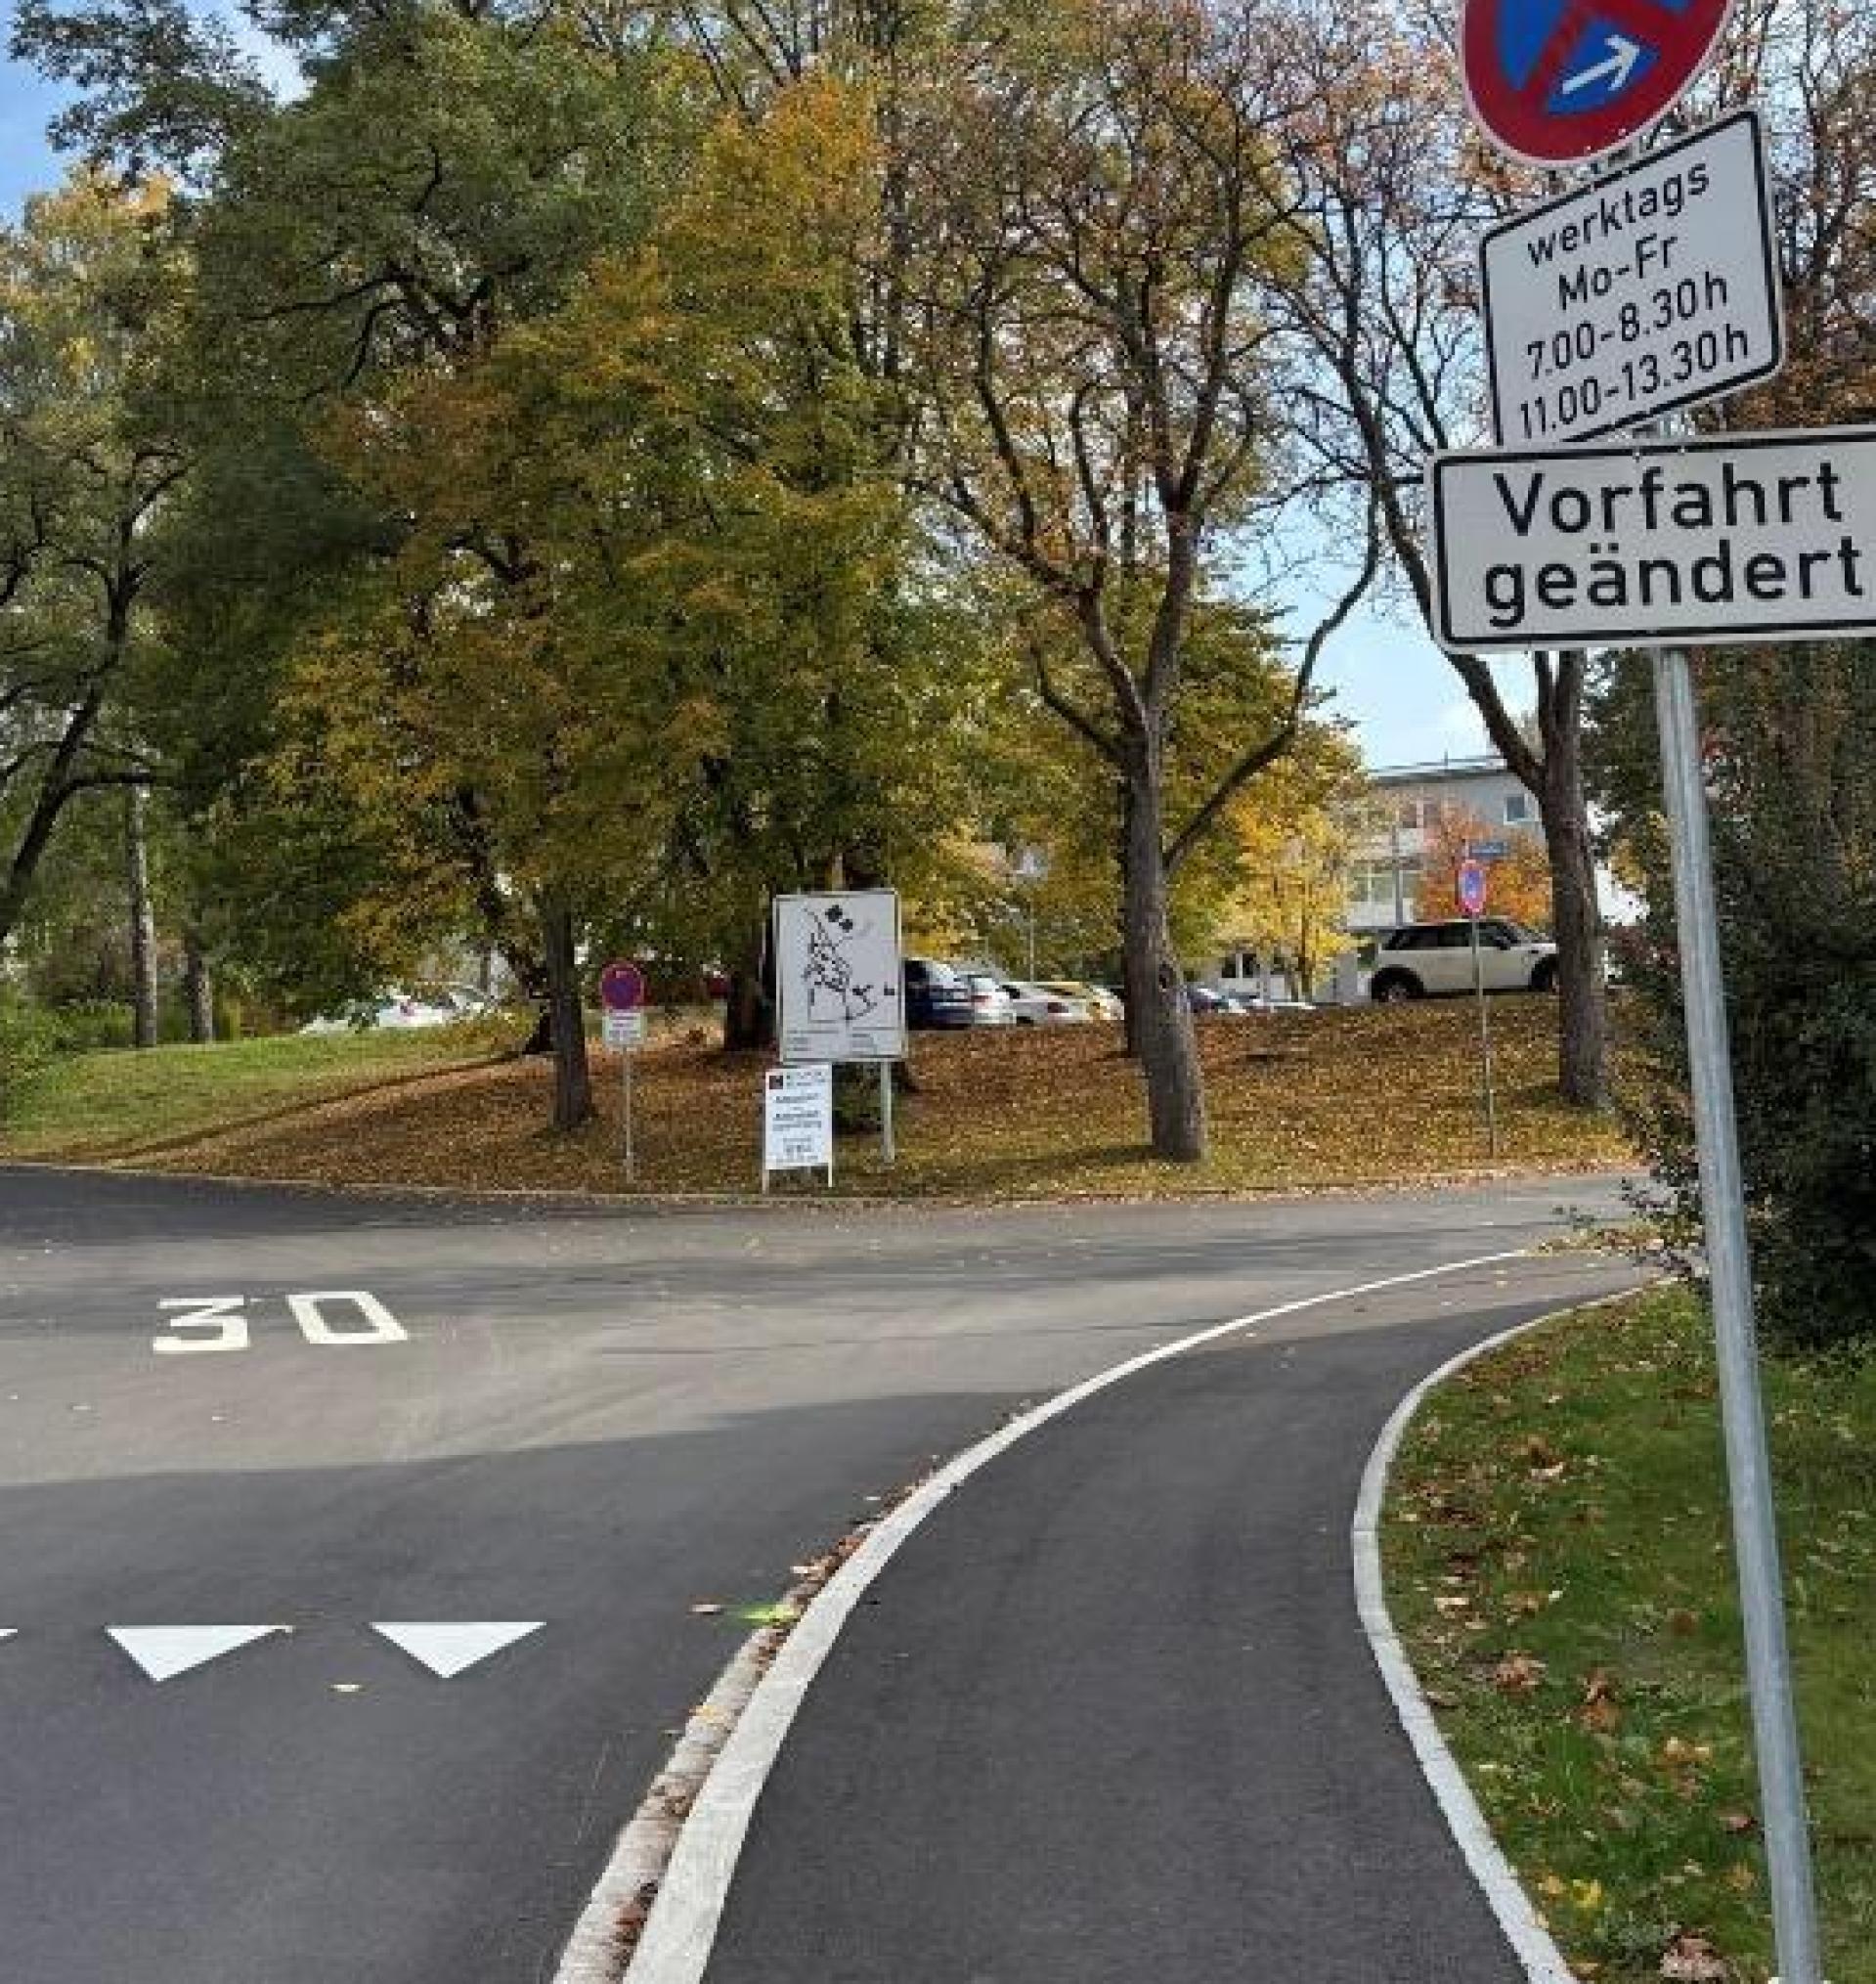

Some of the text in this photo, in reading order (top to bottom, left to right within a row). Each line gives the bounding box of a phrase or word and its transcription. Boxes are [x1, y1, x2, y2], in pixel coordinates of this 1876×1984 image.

[1528, 163, 1710, 267] werktags
[1559, 233, 1678, 310] Mo-Fr
[1493, 463, 1842, 536] Vorfahrt
[1485, 536, 1863, 629] geändert
[153, 1292, 408, 1354] 30
